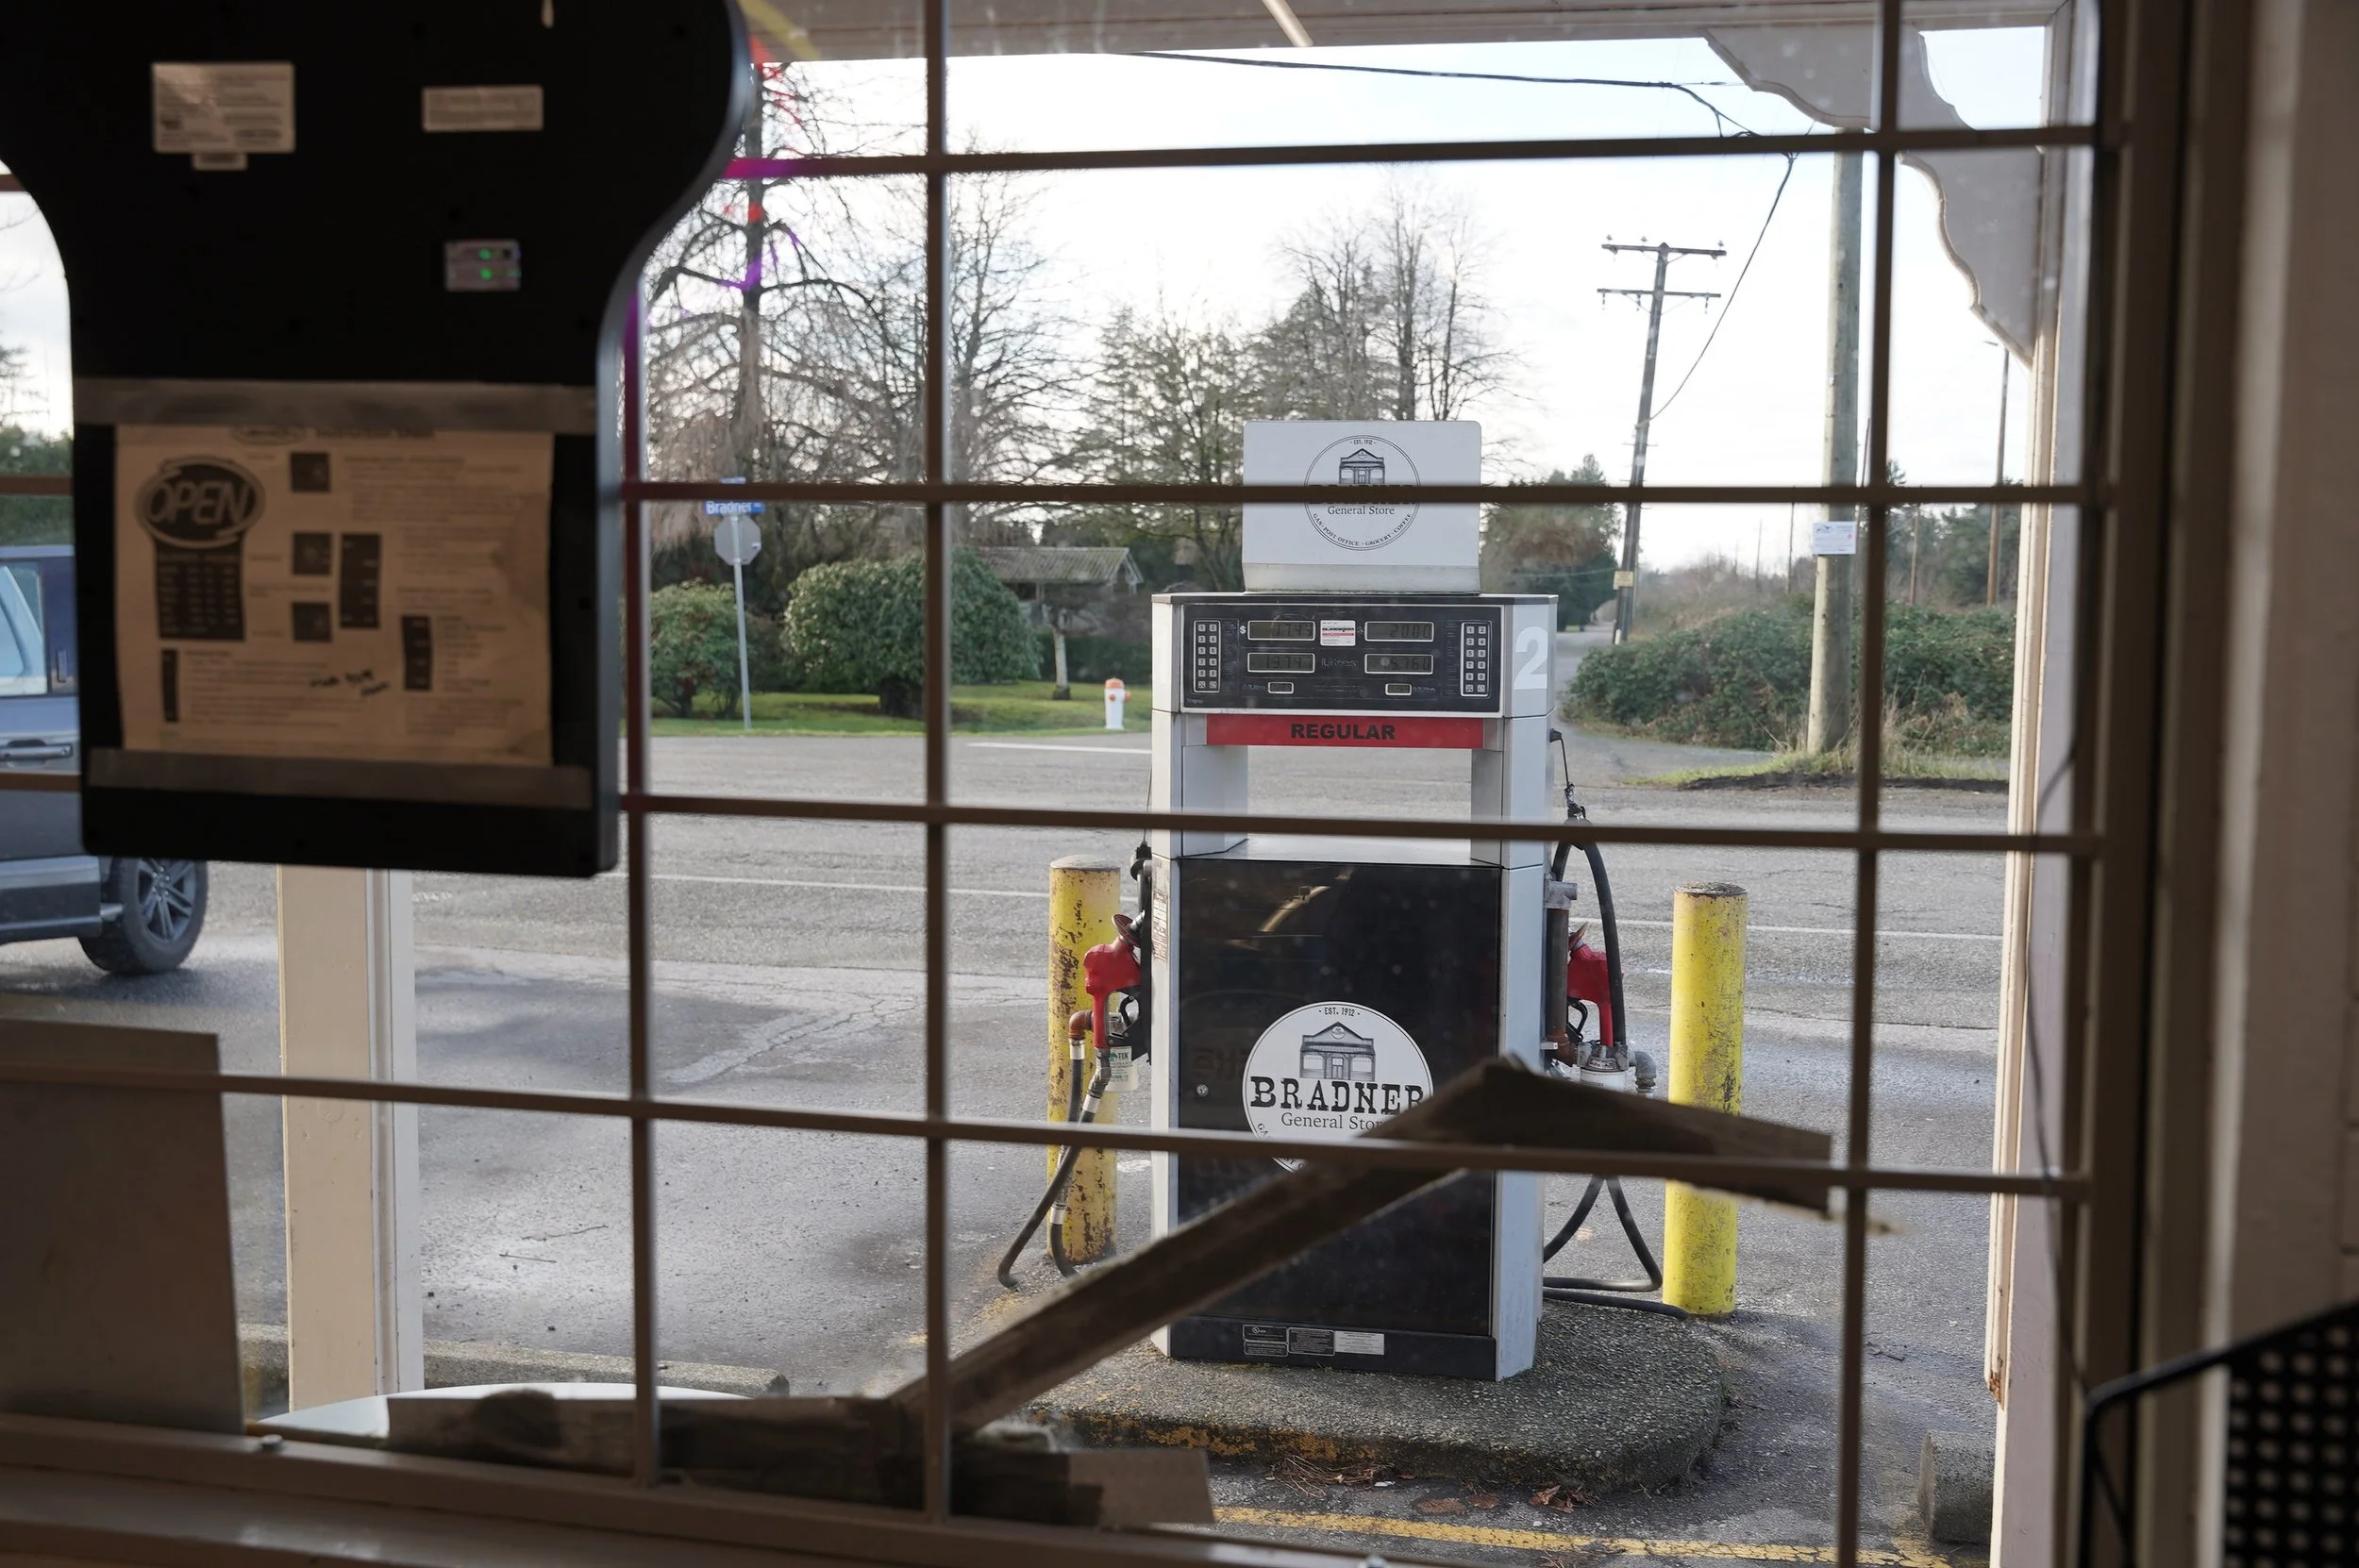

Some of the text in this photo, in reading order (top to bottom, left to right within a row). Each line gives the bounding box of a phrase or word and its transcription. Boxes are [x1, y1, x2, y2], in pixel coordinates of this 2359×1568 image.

[149, 479, 249, 526] OPEN
[1327, 505, 1395, 515] General Store
[1323, 525, 1336, 539] POST
[1338, 536, 1360, 546] OFFICE
[1365, 533, 1392, 546] GROCERY
[1393, 513, 1412, 534] COFFEE
[1238, 625, 1246, 634] $
[1514, 626, 1548, 690] 2
[1291, 723, 1396, 740] REGULAR
[1324, 1007, 1355, 1017] EST. 1912
[1250, 1076, 1424, 1115] BRADNER
[1281, 1112, 1383, 1131] General Stor
